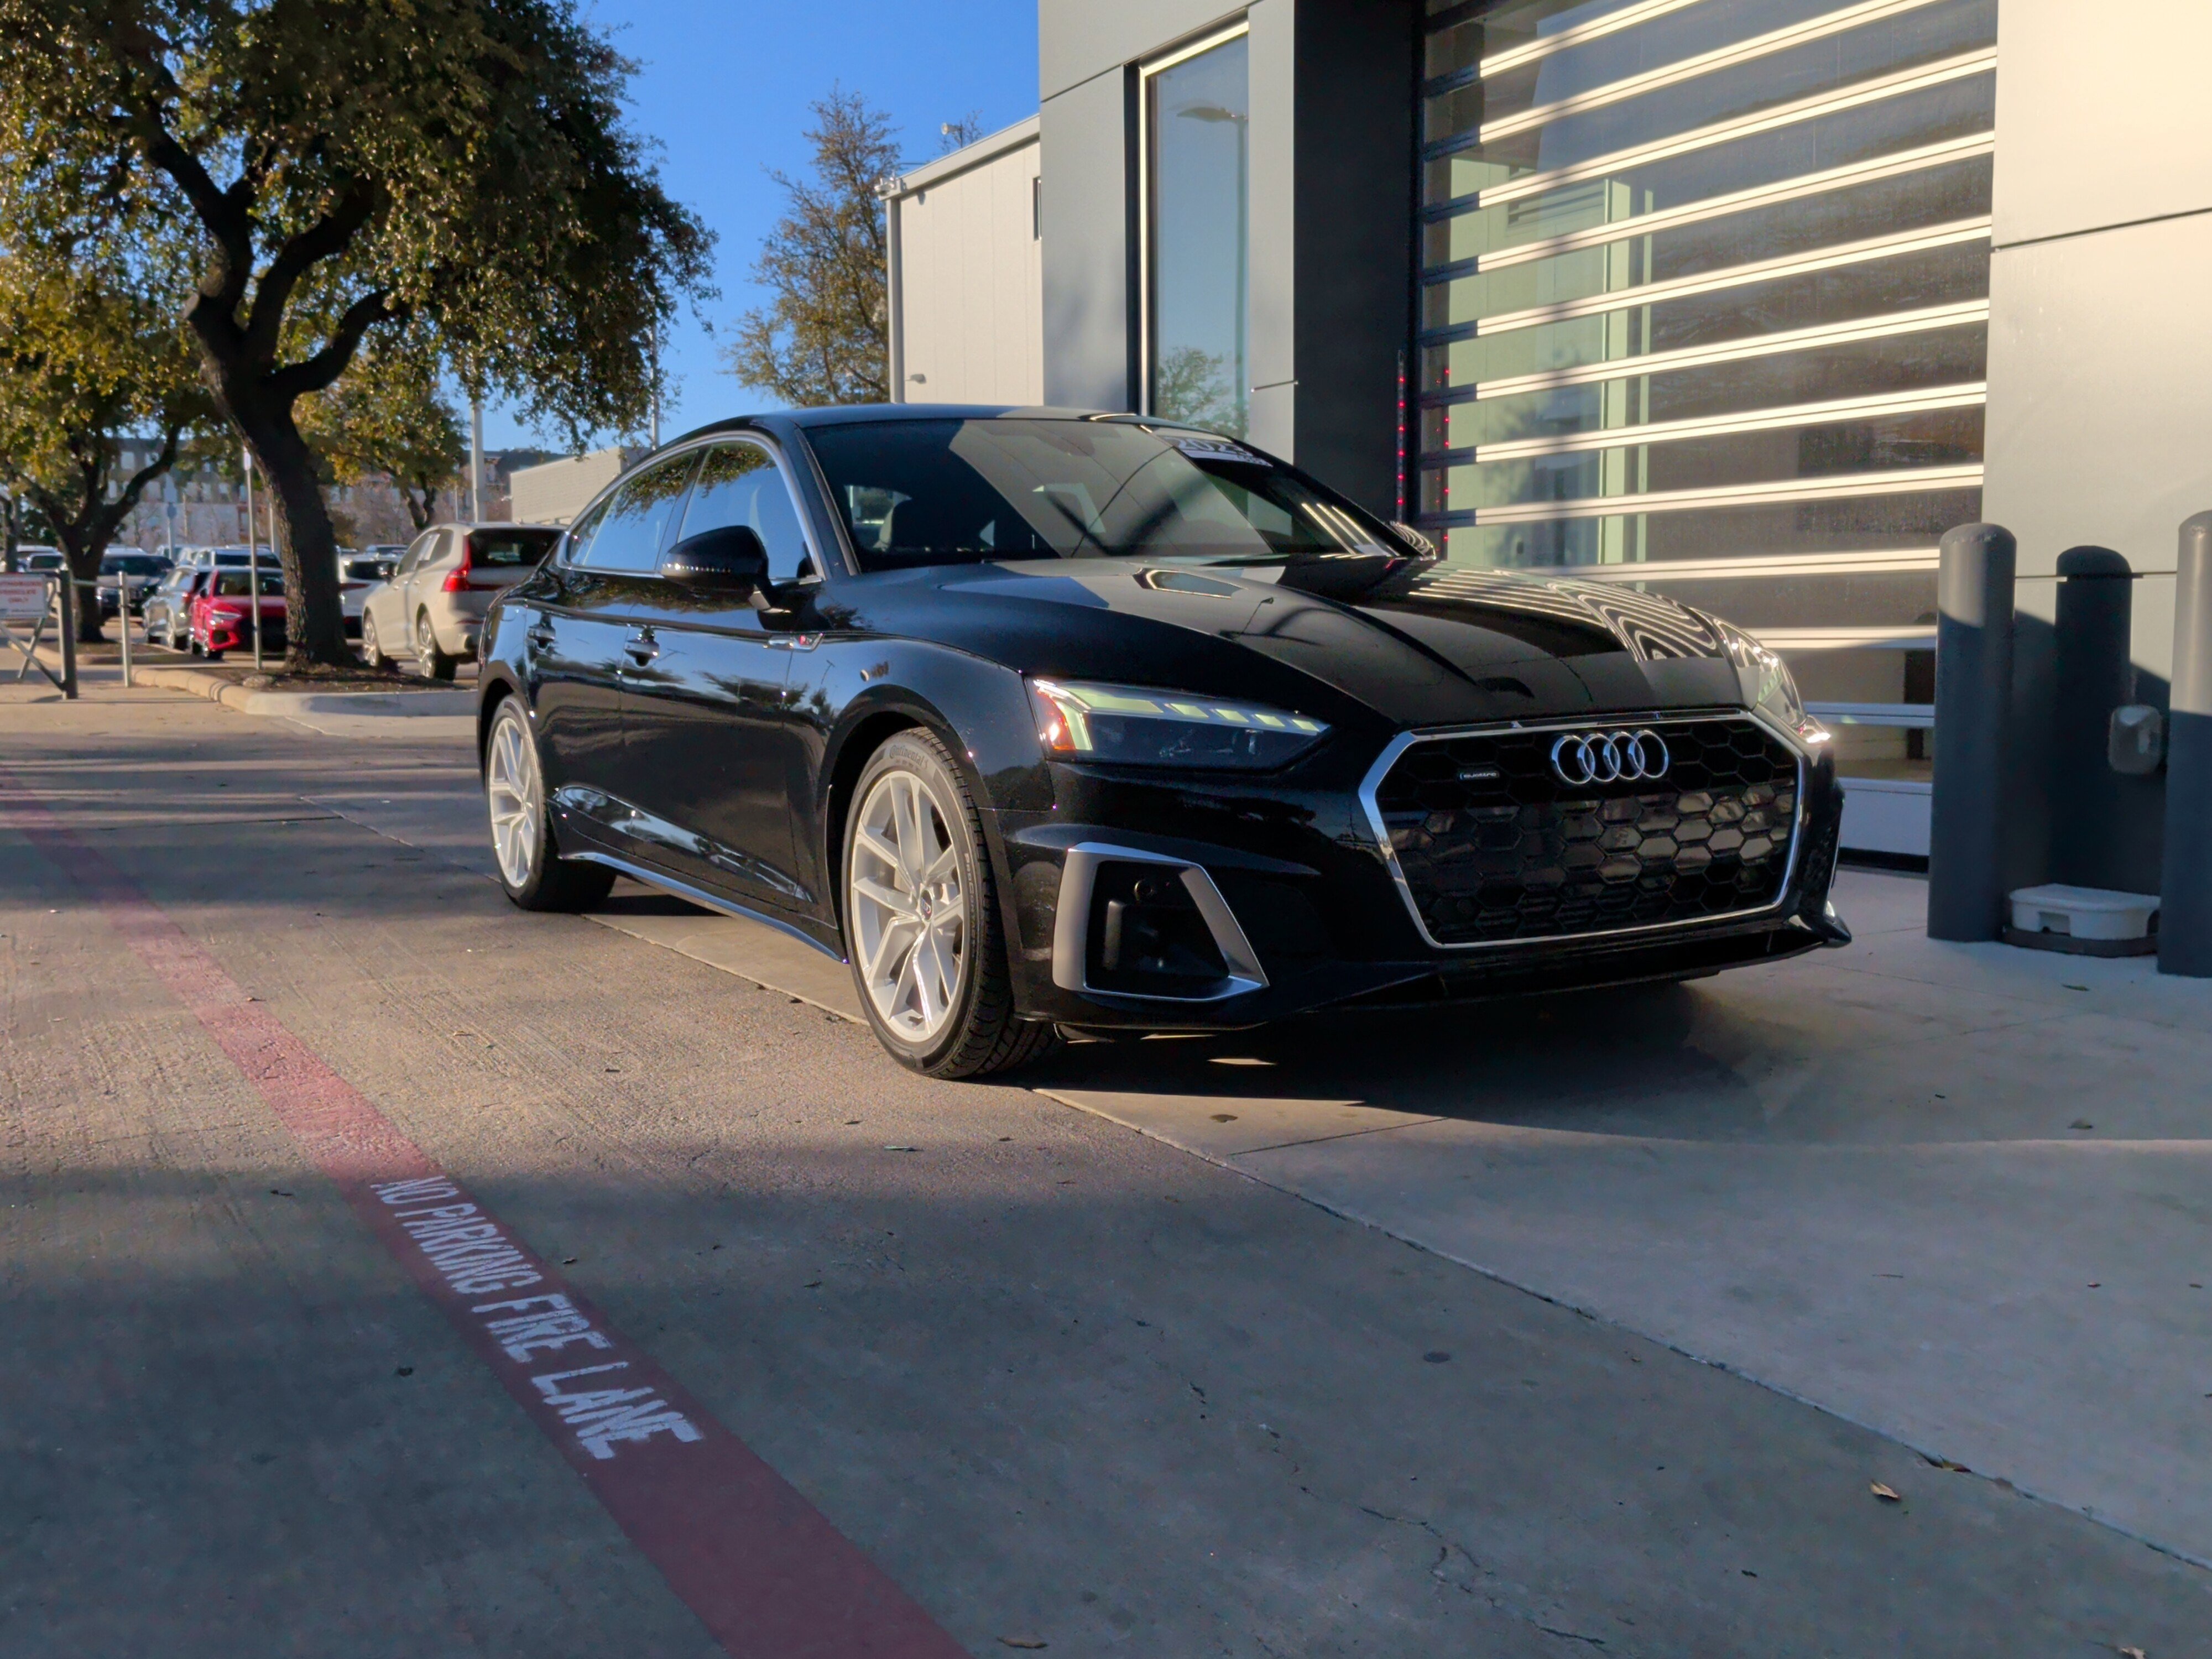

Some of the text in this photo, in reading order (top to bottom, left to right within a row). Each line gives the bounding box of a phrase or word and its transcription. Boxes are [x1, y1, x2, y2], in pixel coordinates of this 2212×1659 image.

[370, 1175, 703, 1459] NO PARKING FIRE LANE
